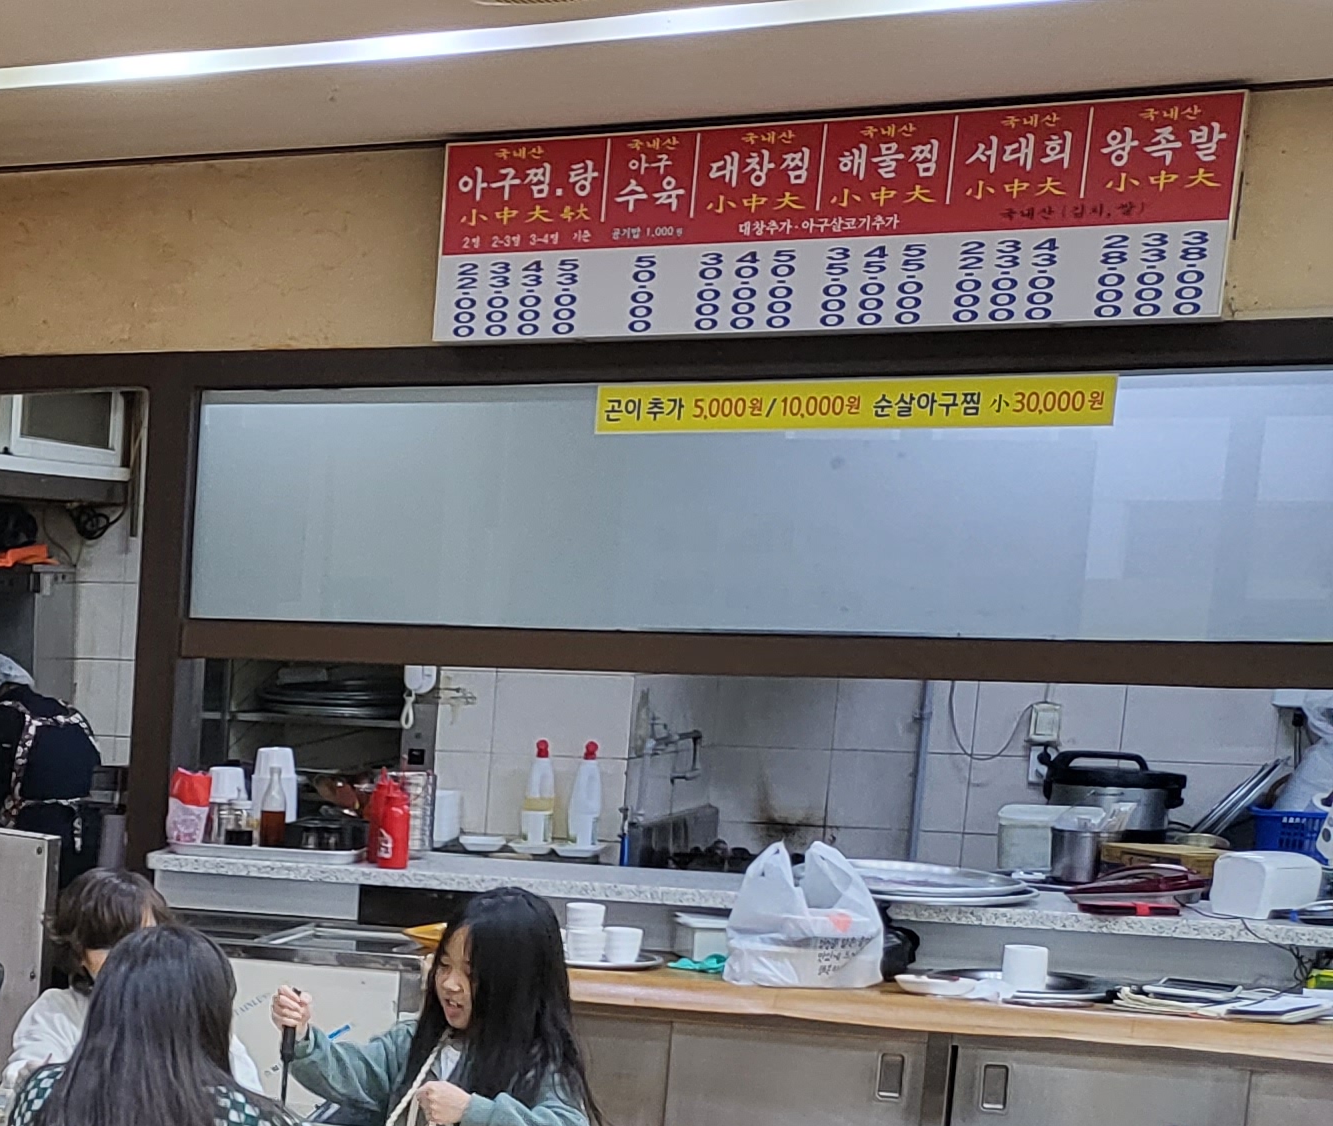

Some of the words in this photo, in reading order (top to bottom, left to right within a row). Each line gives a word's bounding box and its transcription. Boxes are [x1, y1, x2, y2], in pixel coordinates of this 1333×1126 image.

[1000, 112, 1061, 129] 국내산
[1138, 105, 1203, 122] 국내산
[741, 130, 796, 145] 국내산
[860, 123, 917, 138] 국내산
[495, 146, 544, 160] 국내산
[627, 137, 679, 150] 국내산
[965, 130, 1073, 173] 서대회
[1100, 121, 1227, 167] 왕족발
[629, 154, 672, 175] 아구
[709, 146, 810, 188] 대창찜
[838, 139, 939, 181] 해물찜
[615, 176, 685, 212] 수육
[604, 397, 642, 422] 곤이
[646, 397, 685, 421] 추가
[872, 391, 982, 418] 순살아구찜
